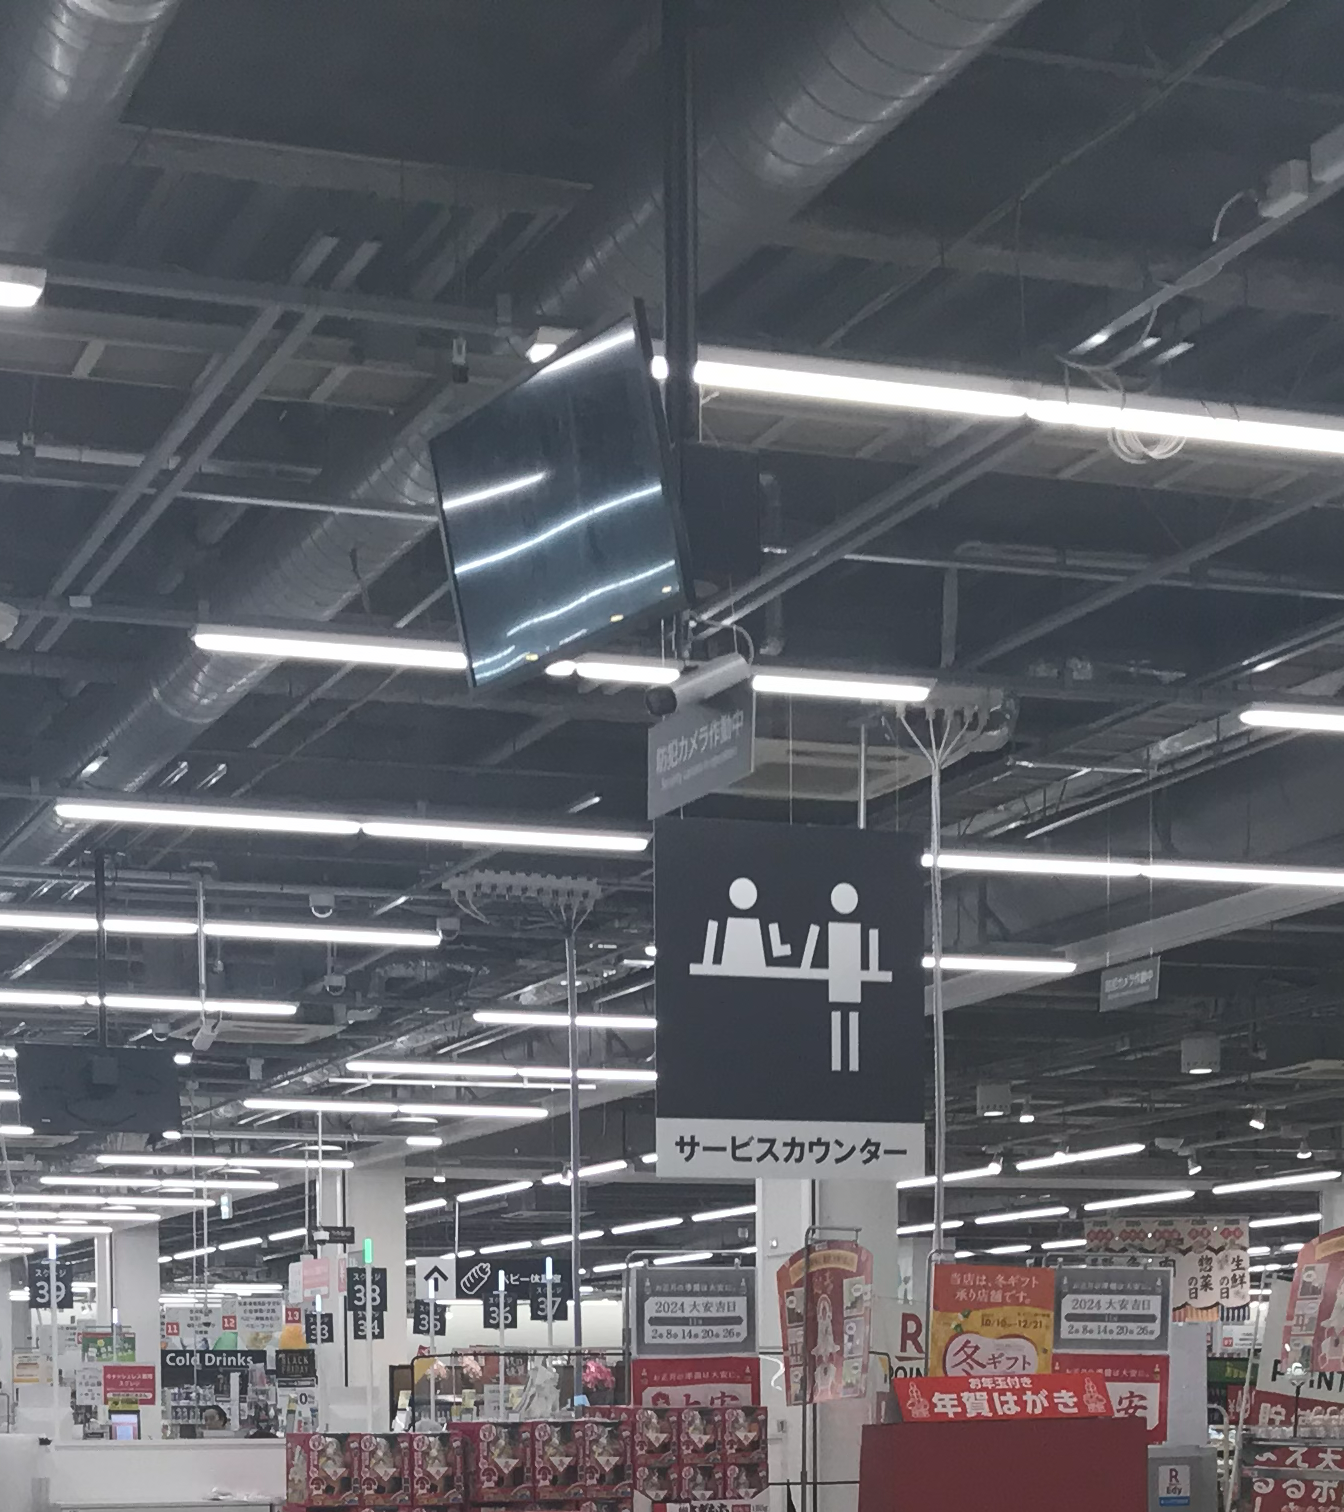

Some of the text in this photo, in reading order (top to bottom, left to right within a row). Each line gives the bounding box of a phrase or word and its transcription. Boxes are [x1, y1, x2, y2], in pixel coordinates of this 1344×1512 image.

[656, 709, 744, 773] 防犯カメラ作動中
[674, 1134, 908, 1165] サービスカウンター
[951, 1272, 1039, 1289] 当店は、冬ギフト
[1197, 1254, 1214, 1292] 惣菜
[1230, 1255, 1247, 1289] 生鮮
[35, 1281, 66, 1303] 39
[353, 1285, 381, 1306] 38
[955, 1288, 1032, 1304] 承り店舗です。
[1188, 1276, 1199, 1300] の日
[1219, 1276, 1230, 1300] の日
[655, 1301, 736, 1313] 2024 大安吉日
[1071, 1299, 1151, 1311] 2024 大安吉日
[224, 1319, 235, 1327] 12
[287, 1312, 299, 1320] 13
[167, 1325, 178, 1333] 11
[900, 1312, 925, 1354] R
[165, 1353, 254, 1367] Cold Drinks
[951, 1338, 1032, 1376] 冬ギフト
[968, 1376, 1033, 1389] お年玉付き
[931, 1388, 1078, 1419] 年賀はがき
[1168, 1467, 1180, 1484] R
[1166, 1485, 1182, 1496] Edy
